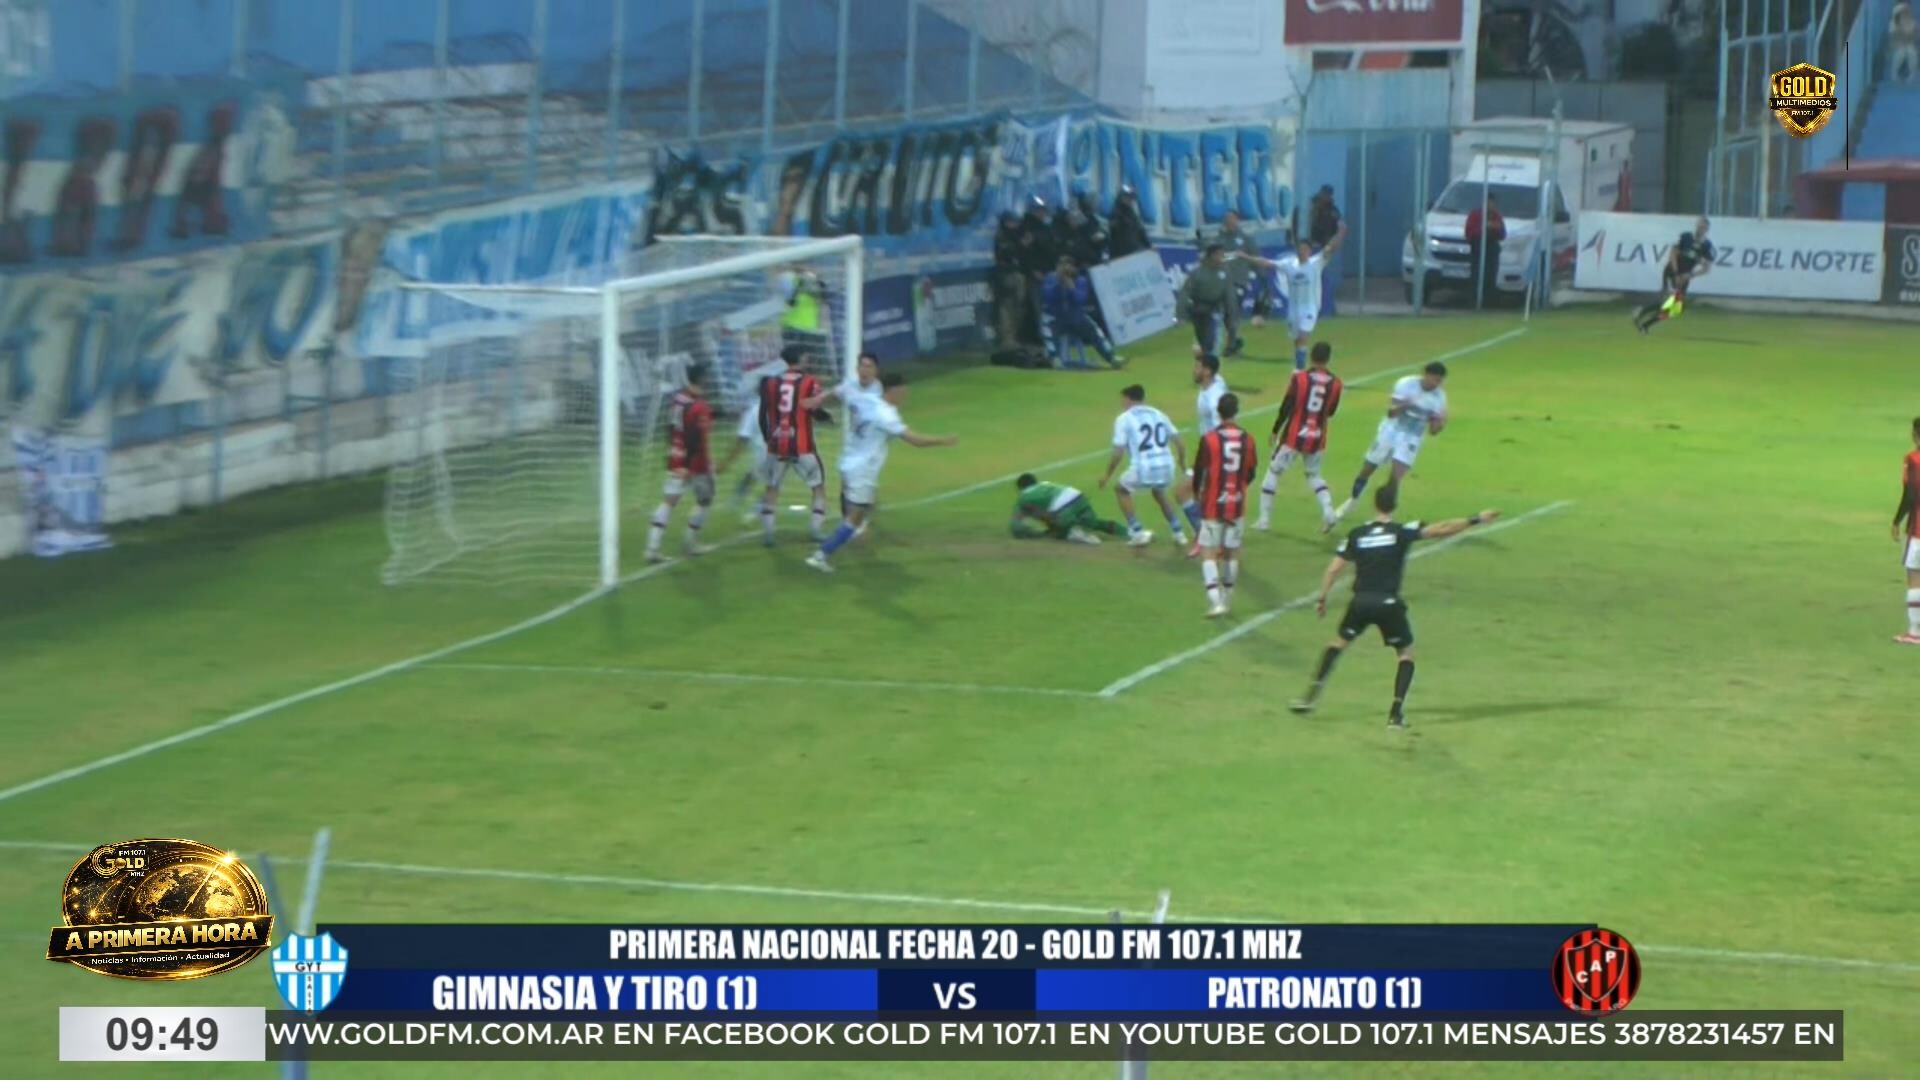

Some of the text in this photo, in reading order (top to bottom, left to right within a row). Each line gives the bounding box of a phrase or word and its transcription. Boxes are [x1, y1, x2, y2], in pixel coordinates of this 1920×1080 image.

[1614, 242, 1646, 263] LA
[1740, 248, 1785, 271] DEL
[1790, 250, 1876, 274] NORTE
[778, 384, 794, 412] 3
[1307, 385, 1327, 413] 6
[1138, 422, 1169, 452] 20
[1223, 441, 1242, 471] 5
